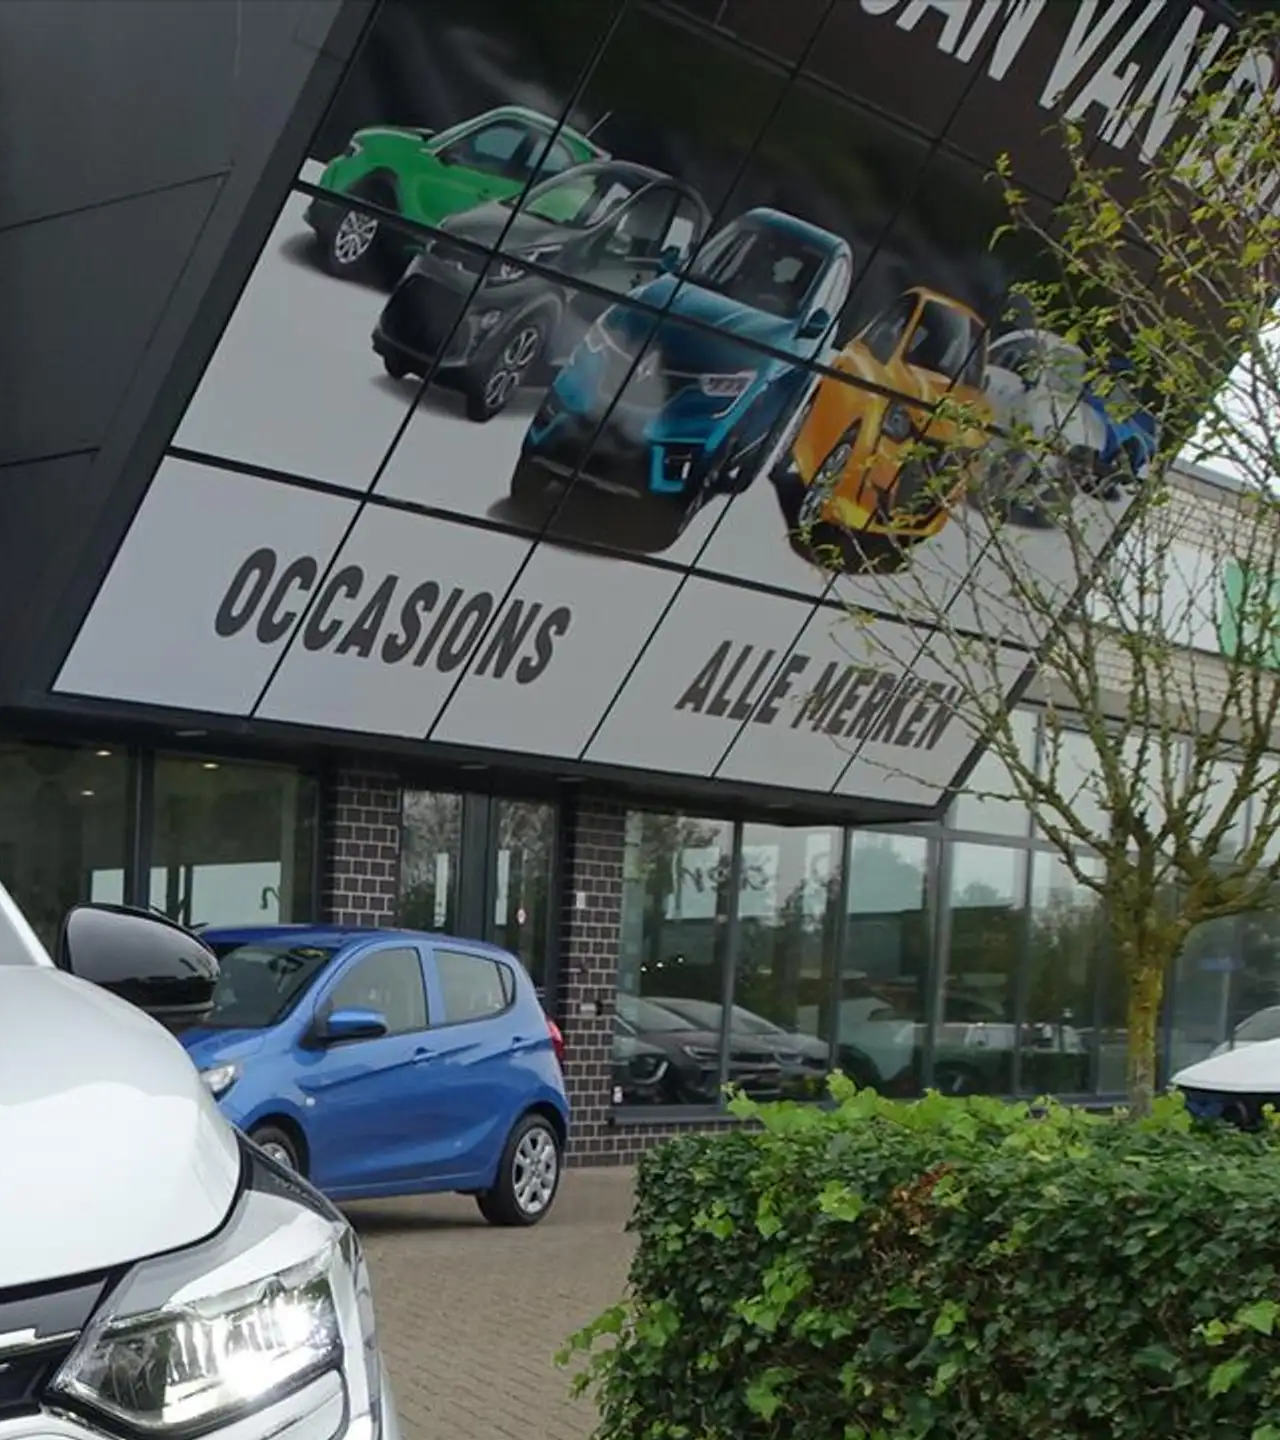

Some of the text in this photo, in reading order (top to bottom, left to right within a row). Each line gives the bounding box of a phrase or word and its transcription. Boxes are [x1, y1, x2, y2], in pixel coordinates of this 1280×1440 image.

[215, 548, 571, 684] OCCASIONS
[674, 640, 966, 751] ALLE MERKEN
